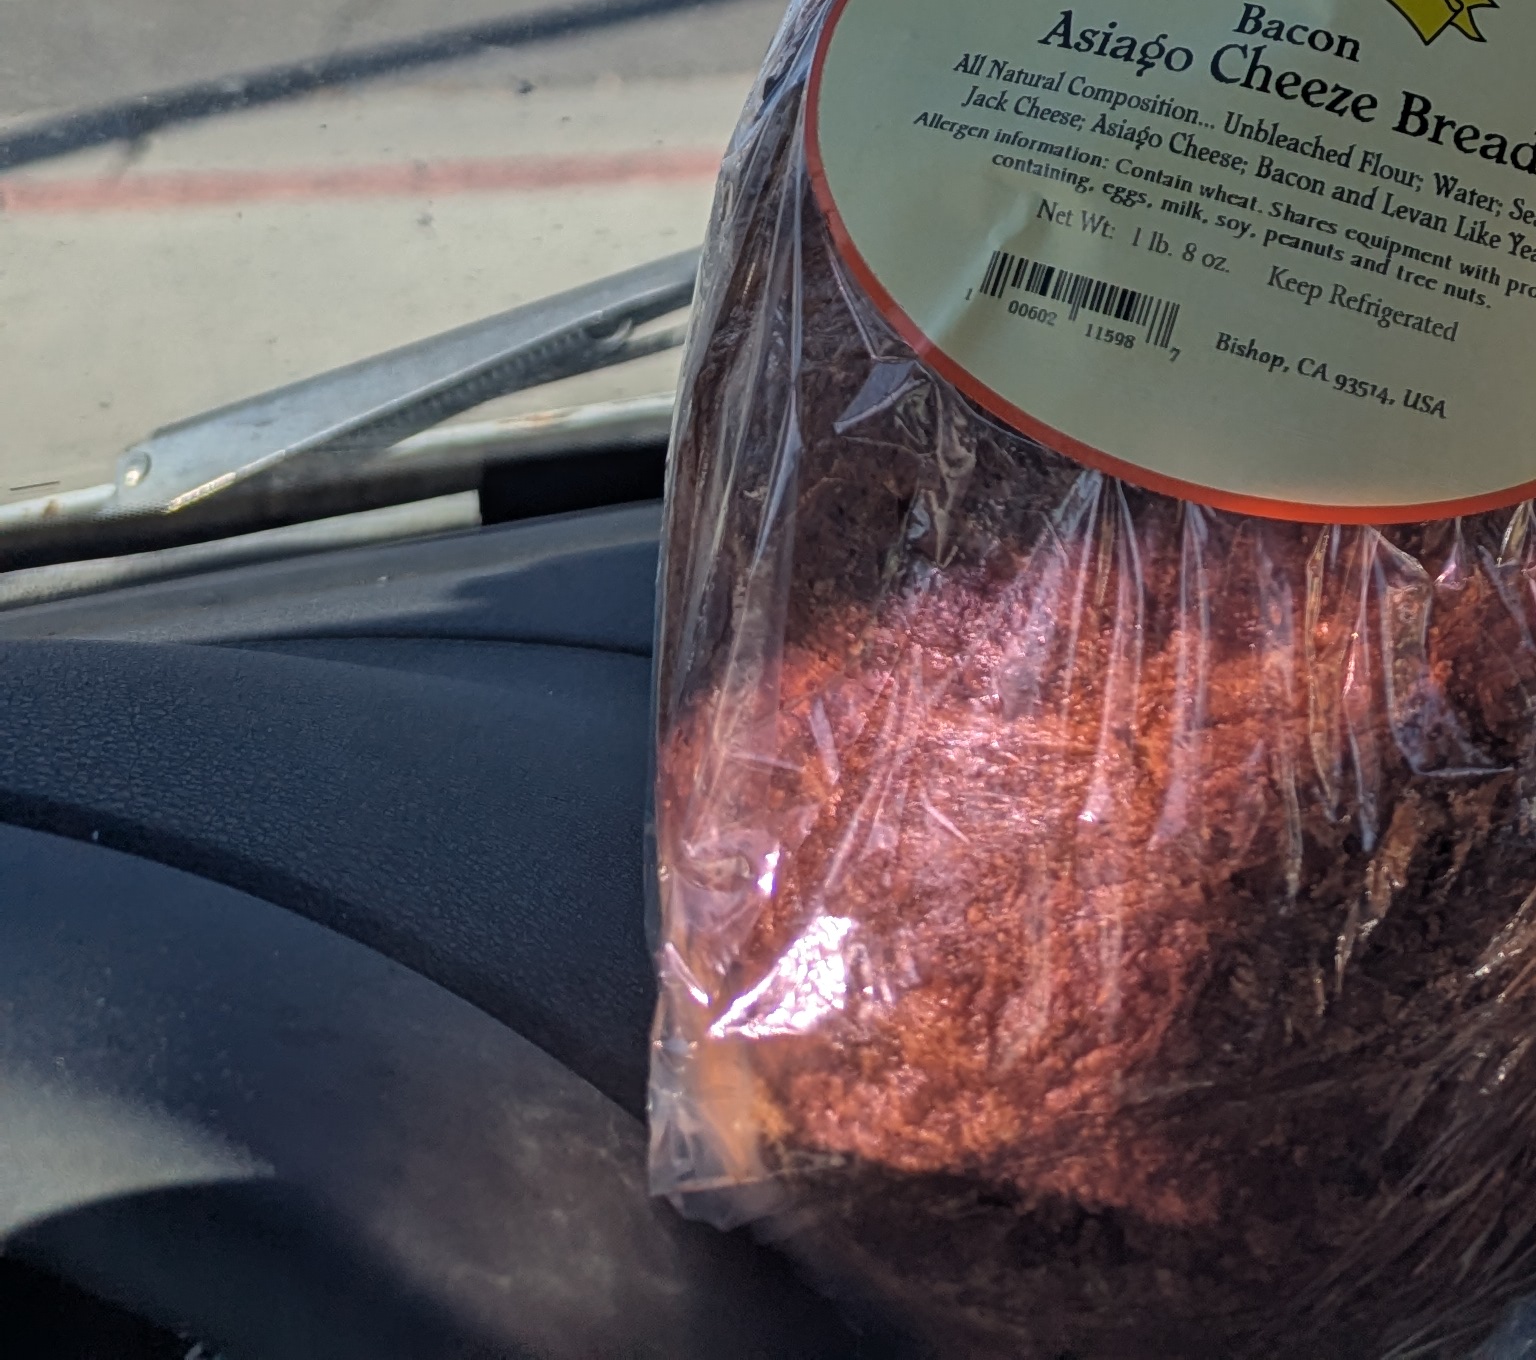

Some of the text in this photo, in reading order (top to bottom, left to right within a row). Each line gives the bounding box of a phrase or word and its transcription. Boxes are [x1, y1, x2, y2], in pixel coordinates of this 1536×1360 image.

[1038, 10, 1193, 76] Asiago
[1211, 43, 1378, 123] Cheeze
[1233, 2, 1360, 62] Bacon
[953, 53, 987, 76] All
[986, 60, 1066, 92] Natural
[1068, 76, 1214, 129] Composition...
[1224, 111, 1355, 168] Unbleached
[1358, 151, 1424, 192] Flour;
[1433, 173, 1503, 216] Water;
[961, 86, 1008, 112] Jack
[1014, 95, 1086, 130] Cheese;
[1091, 114, 1163, 150] Asiago
[1169, 132, 1248, 175] Cheese;
[1254, 156, 1325, 196] Bacon
[1331, 184, 1378, 210] and
[1381, 193, 1448, 233] Levan
[1454, 217, 1501, 249] Like
[913, 112, 989, 140] Allergen
[994, 129, 1110, 168] information:
[1116, 159, 1192, 193] Contain
[1199, 183, 1263, 215] wheat.
[1269, 202, 1337, 235] Shares
[1345, 227, 1452, 270] equipment
[1459, 260, 1501, 286] with
[1036, 199, 1230, 273] Net Wt: 1 lb. 8 oz.
[1262, 227, 1344, 262] peanuts
[1350, 253, 1391, 276] and
[1396, 264, 1437, 291] tree
[1443, 281, 1491, 309] nuts.
[1267, 265, 1459, 342] Keep Refrigerated
[965, 288, 1181, 362] 1 00602 11598 7
[1215, 332, 1446, 419] Bishop, CA 93514, USA
